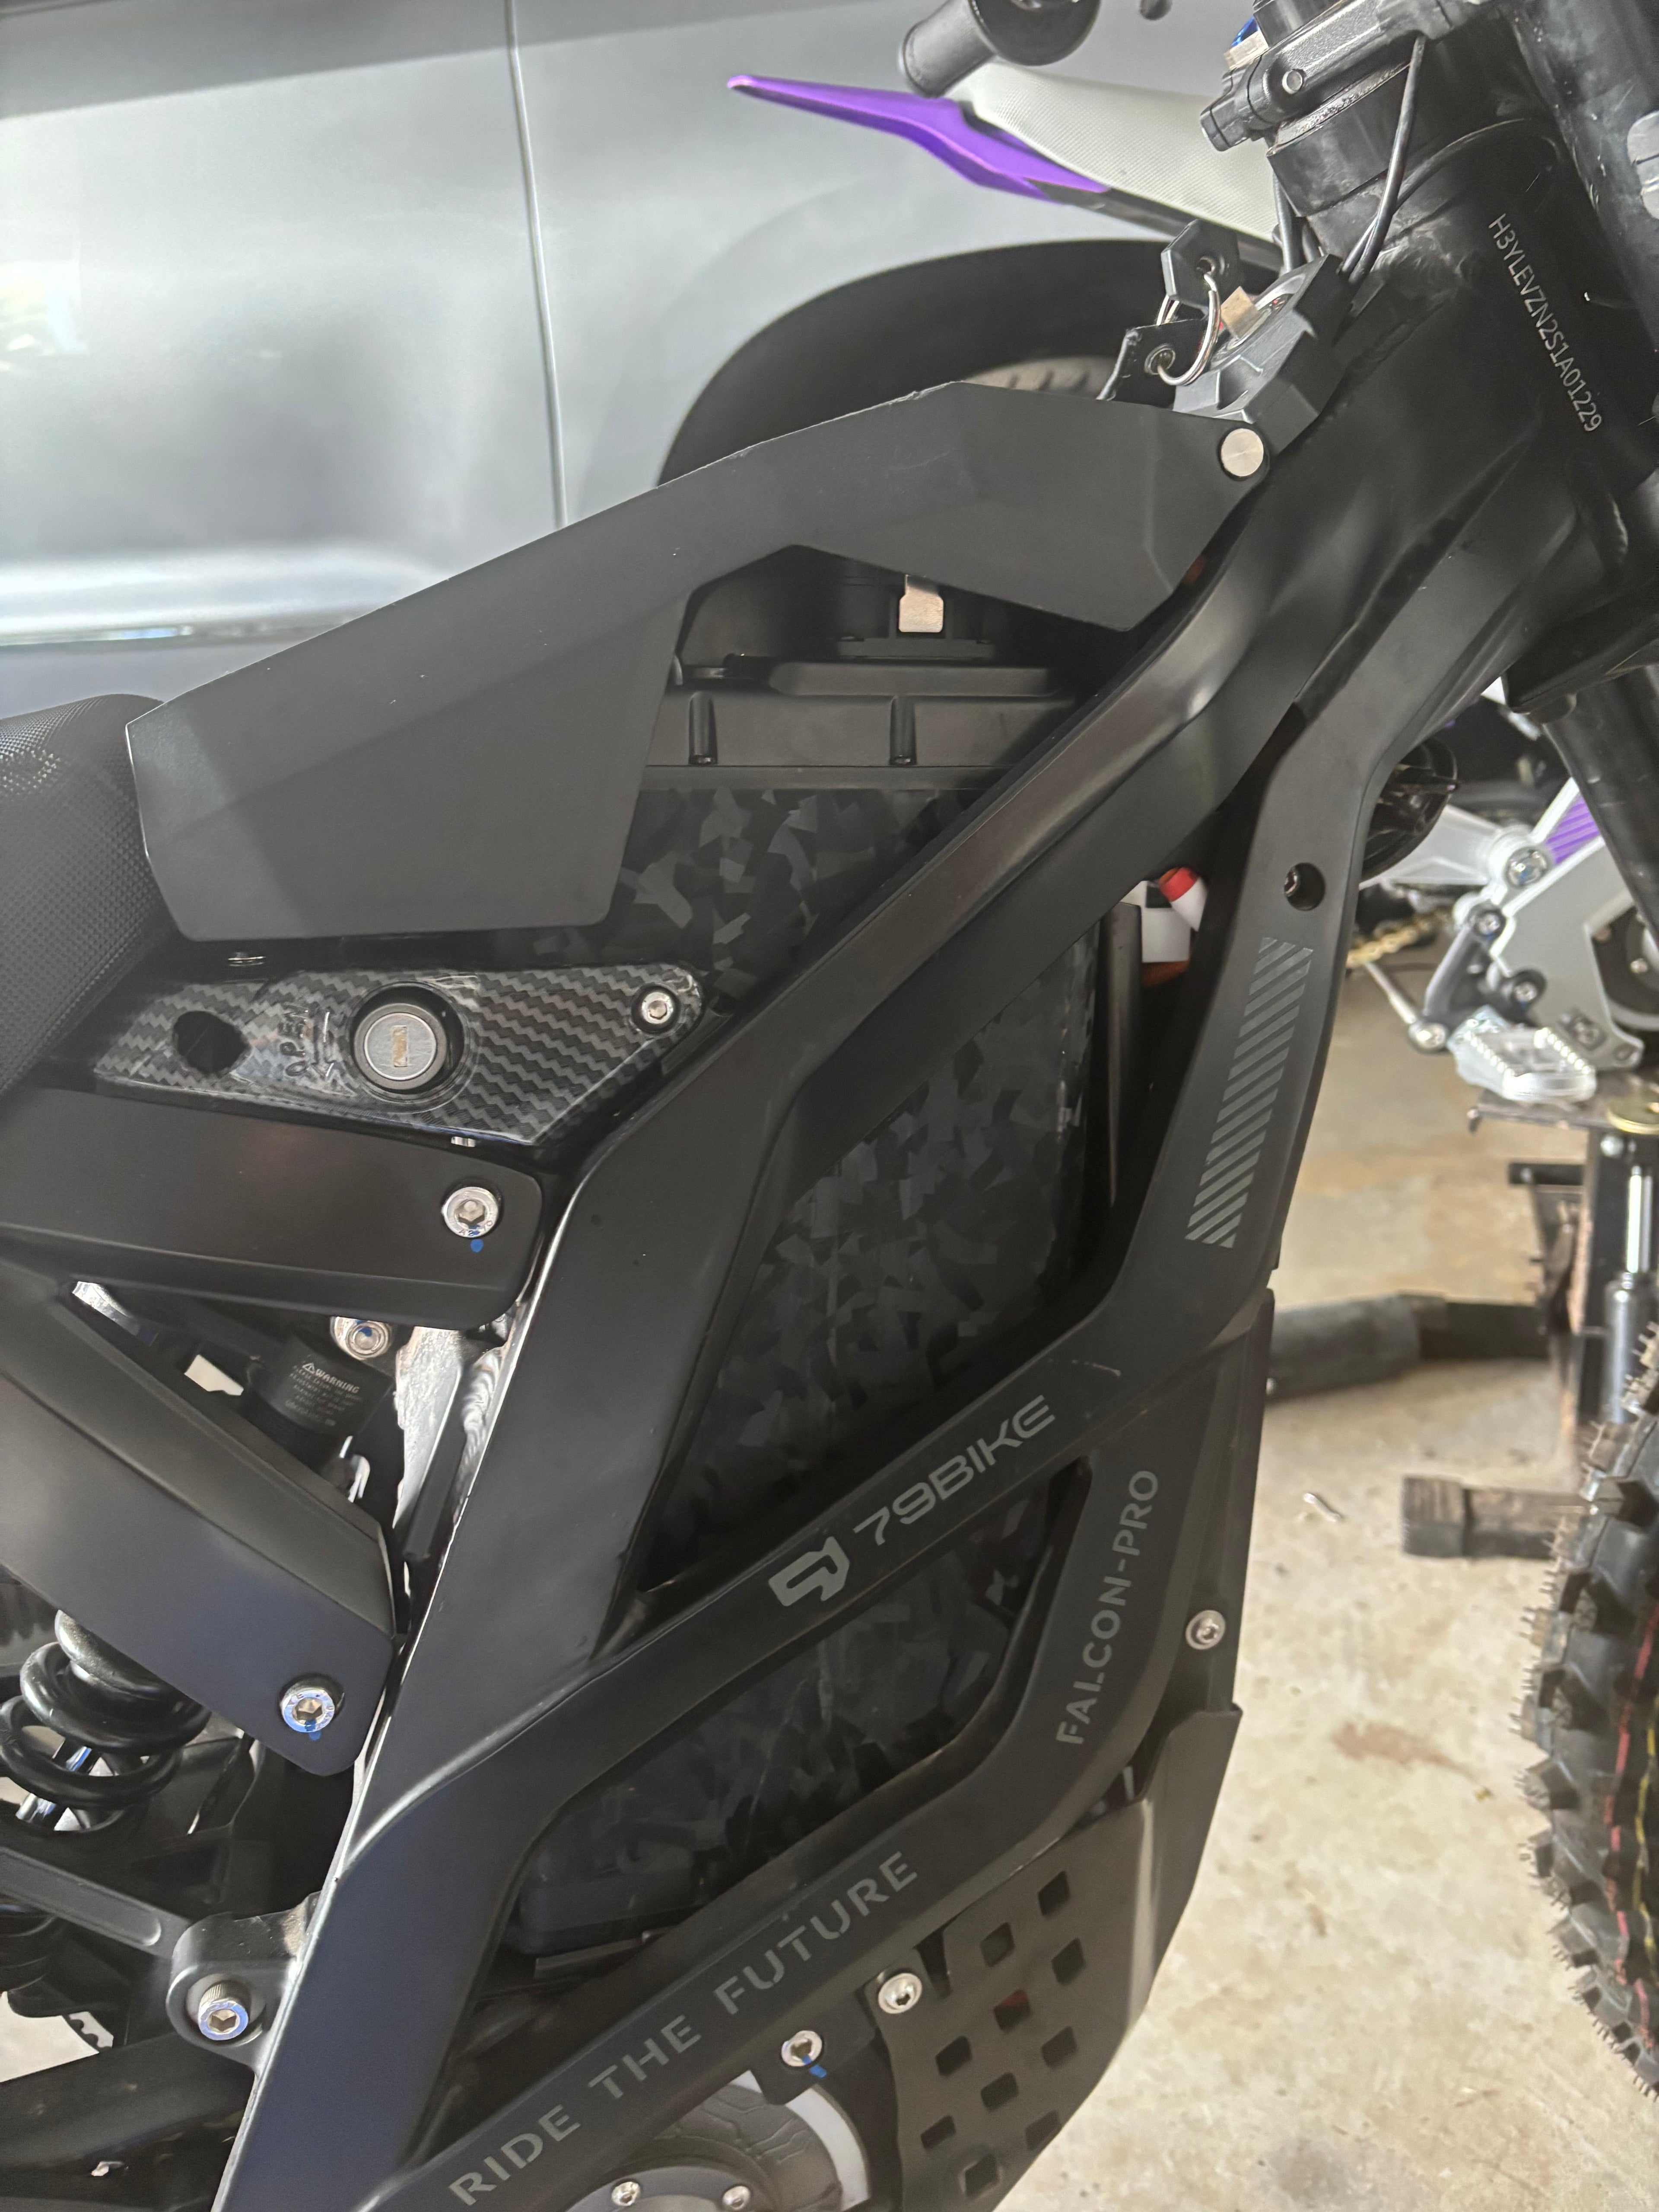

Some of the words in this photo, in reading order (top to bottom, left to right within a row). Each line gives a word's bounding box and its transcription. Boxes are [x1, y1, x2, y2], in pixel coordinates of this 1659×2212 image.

[1488, 213, 1602, 432] H3YLEVZN2S1A01229
[278, 1004, 309, 1076] OPEN
[315, 1369, 360, 1393] WARNING
[853, 1395, 1055, 1546] 79BIKE
[1056, 1471, 1158, 1744] FALCON-PRO
[449, 2104, 581, 2206] RIDE
[589, 2015, 702, 2098] THE
[713, 1852, 918, 2015] FUTURE
